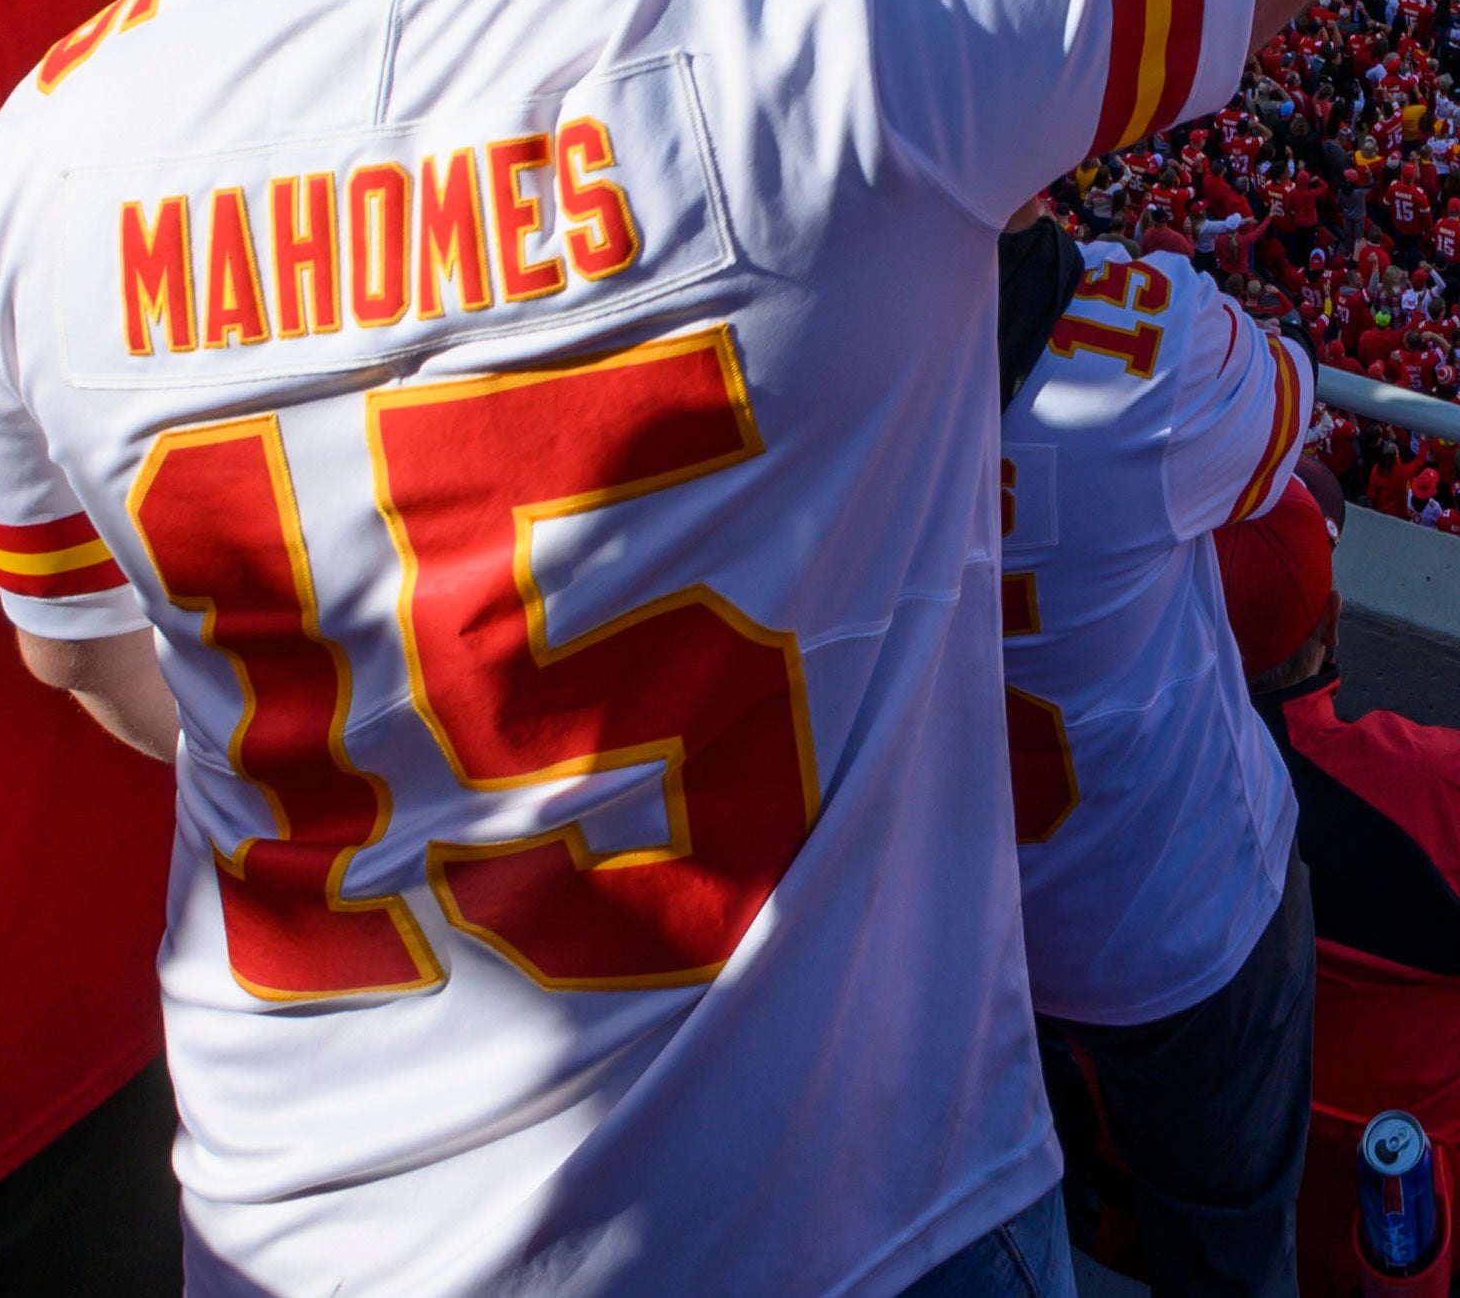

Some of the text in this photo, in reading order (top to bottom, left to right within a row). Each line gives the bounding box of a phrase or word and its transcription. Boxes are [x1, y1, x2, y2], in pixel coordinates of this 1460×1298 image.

[117, 114, 641, 358] MAHOMES
[1047, 243, 1172, 380] 15
[125, 322, 822, 1002] 15
